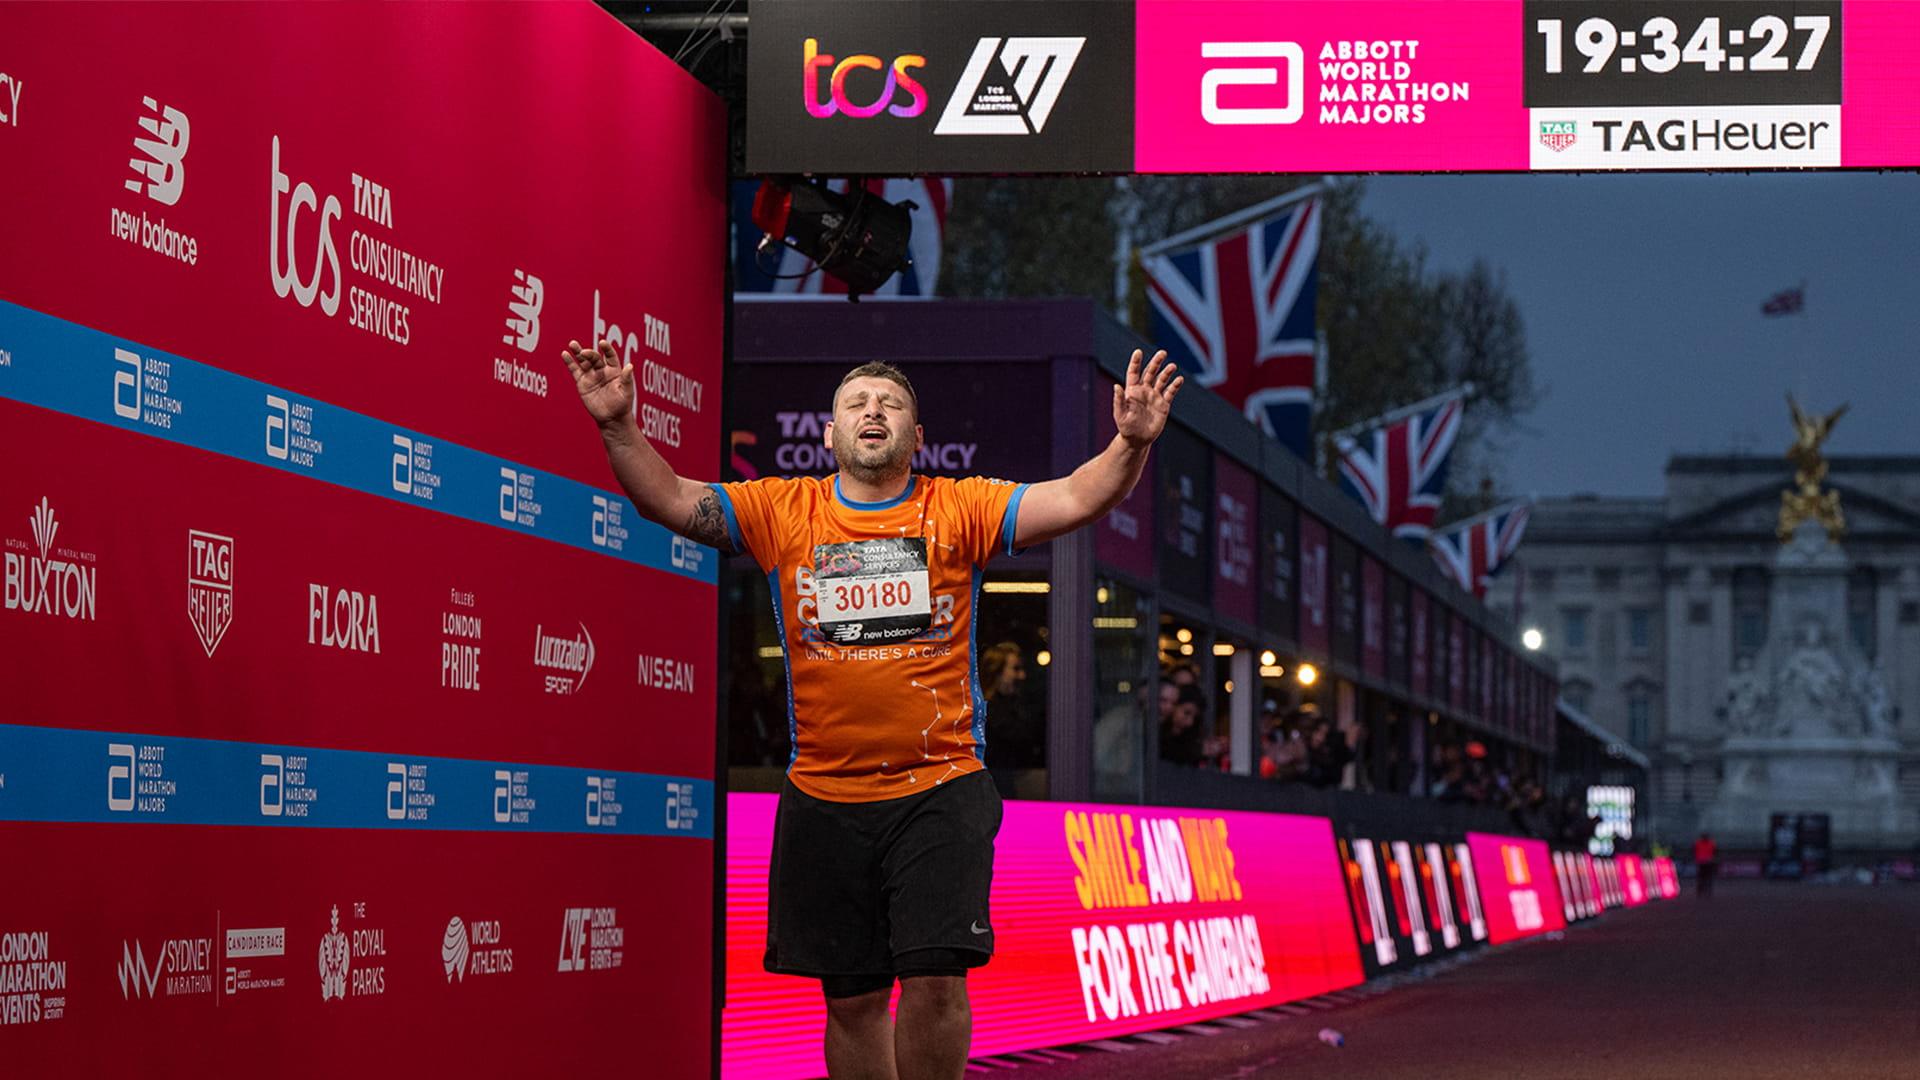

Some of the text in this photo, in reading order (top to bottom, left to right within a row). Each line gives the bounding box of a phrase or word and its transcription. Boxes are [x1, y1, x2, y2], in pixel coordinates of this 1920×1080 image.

[1319, 40, 1419, 60] ABBOTT
[1537, 15, 1831, 74] 19:34:27
[804, 38, 928, 118] tcs
[1319, 62, 1411, 81] WORLD
[1319, 82, 1470, 102] MARATHON
[1319, 104, 1426, 124] MAJORS
[1542, 123, 1573, 133] TAG
[352, 172, 393, 229] TATA
[111, 207, 198, 266] new balance
[271, 135, 342, 317] tcs
[350, 230, 444, 304] CONSULTANCY
[349, 286, 410, 345] SERVICES
[644, 313, 671, 356] TATA
[144, 358, 170, 377] ABBOTT
[494, 358, 548, 398] new balance
[144, 374, 168, 393] WORLD
[642, 359, 703, 413] CONSULTANCY
[144, 392, 182, 414] MARATHON
[291, 403, 312, 421] ABBOTT
[144, 408, 171, 429] MAJORS
[291, 417, 311, 435] WORLD
[641, 403, 681, 448] SERVICES
[290, 434, 323, 453] MARATHON
[290, 449, 313, 467] MAJORS
[6, 538, 29, 550] NATURAL
[863, 546, 887, 554] TATA
[57, 548, 96, 562] MINERAL WATER
[193, 540, 230, 580] TAG
[863, 551, 919, 563] CONSULTANCY
[863, 561, 900, 570] SERVICES
[5, 551, 96, 621] BUXTON
[834, 580, 911, 612] 30180
[190, 588, 231, 647] HEUER
[308, 583, 381, 653] FLORA
[443, 611, 481, 640] LONDON
[863, 632, 882, 640] new
[883, 627, 922, 638] balance
[534, 623, 586, 673] Lucozade
[805, 646, 952, 661] UNTIL THERE'S A CURE
[442, 641, 481, 691] PRIDE
[637, 654, 694, 693] NISSAN
[545, 675, 574, 695] SPORT
[139, 746, 164, 761] ABBOTT
[285, 755, 307, 770] ABBOTT
[139, 762, 162, 777] WORLD
[285, 771, 306, 785] WORLD
[138, 779, 176, 795] MARATHON
[285, 787, 317, 801] MARATHON
[138, 797, 165, 812] MAJORS
[285, 803, 308, 817] MAJORS
[1064, 810, 1149, 910] SMILE
[1140, 818, 1193, 904] AND
[354, 902, 366, 918] THE
[591, 907, 616, 928] LONDON
[228, 935, 283, 950] CANDIDATE RACE
[352, 929, 386, 957] ROYAL
[471, 921, 500, 945] WORLD
[591, 927, 624, 948] MARATHON
[0, 931, 48, 962] ONDON
[166, 938, 212, 973] SYDNEY
[471, 949, 513, 975] ATHLETICS
[590, 949, 611, 969] EVENTS
[352, 967, 385, 996] PARKS
[1071, 924, 1140, 1023] FOR
[1126, 922, 1182, 1014] THE
[166, 975, 212, 996] MARATHON
[0, 992, 40, 1024] VENTS
